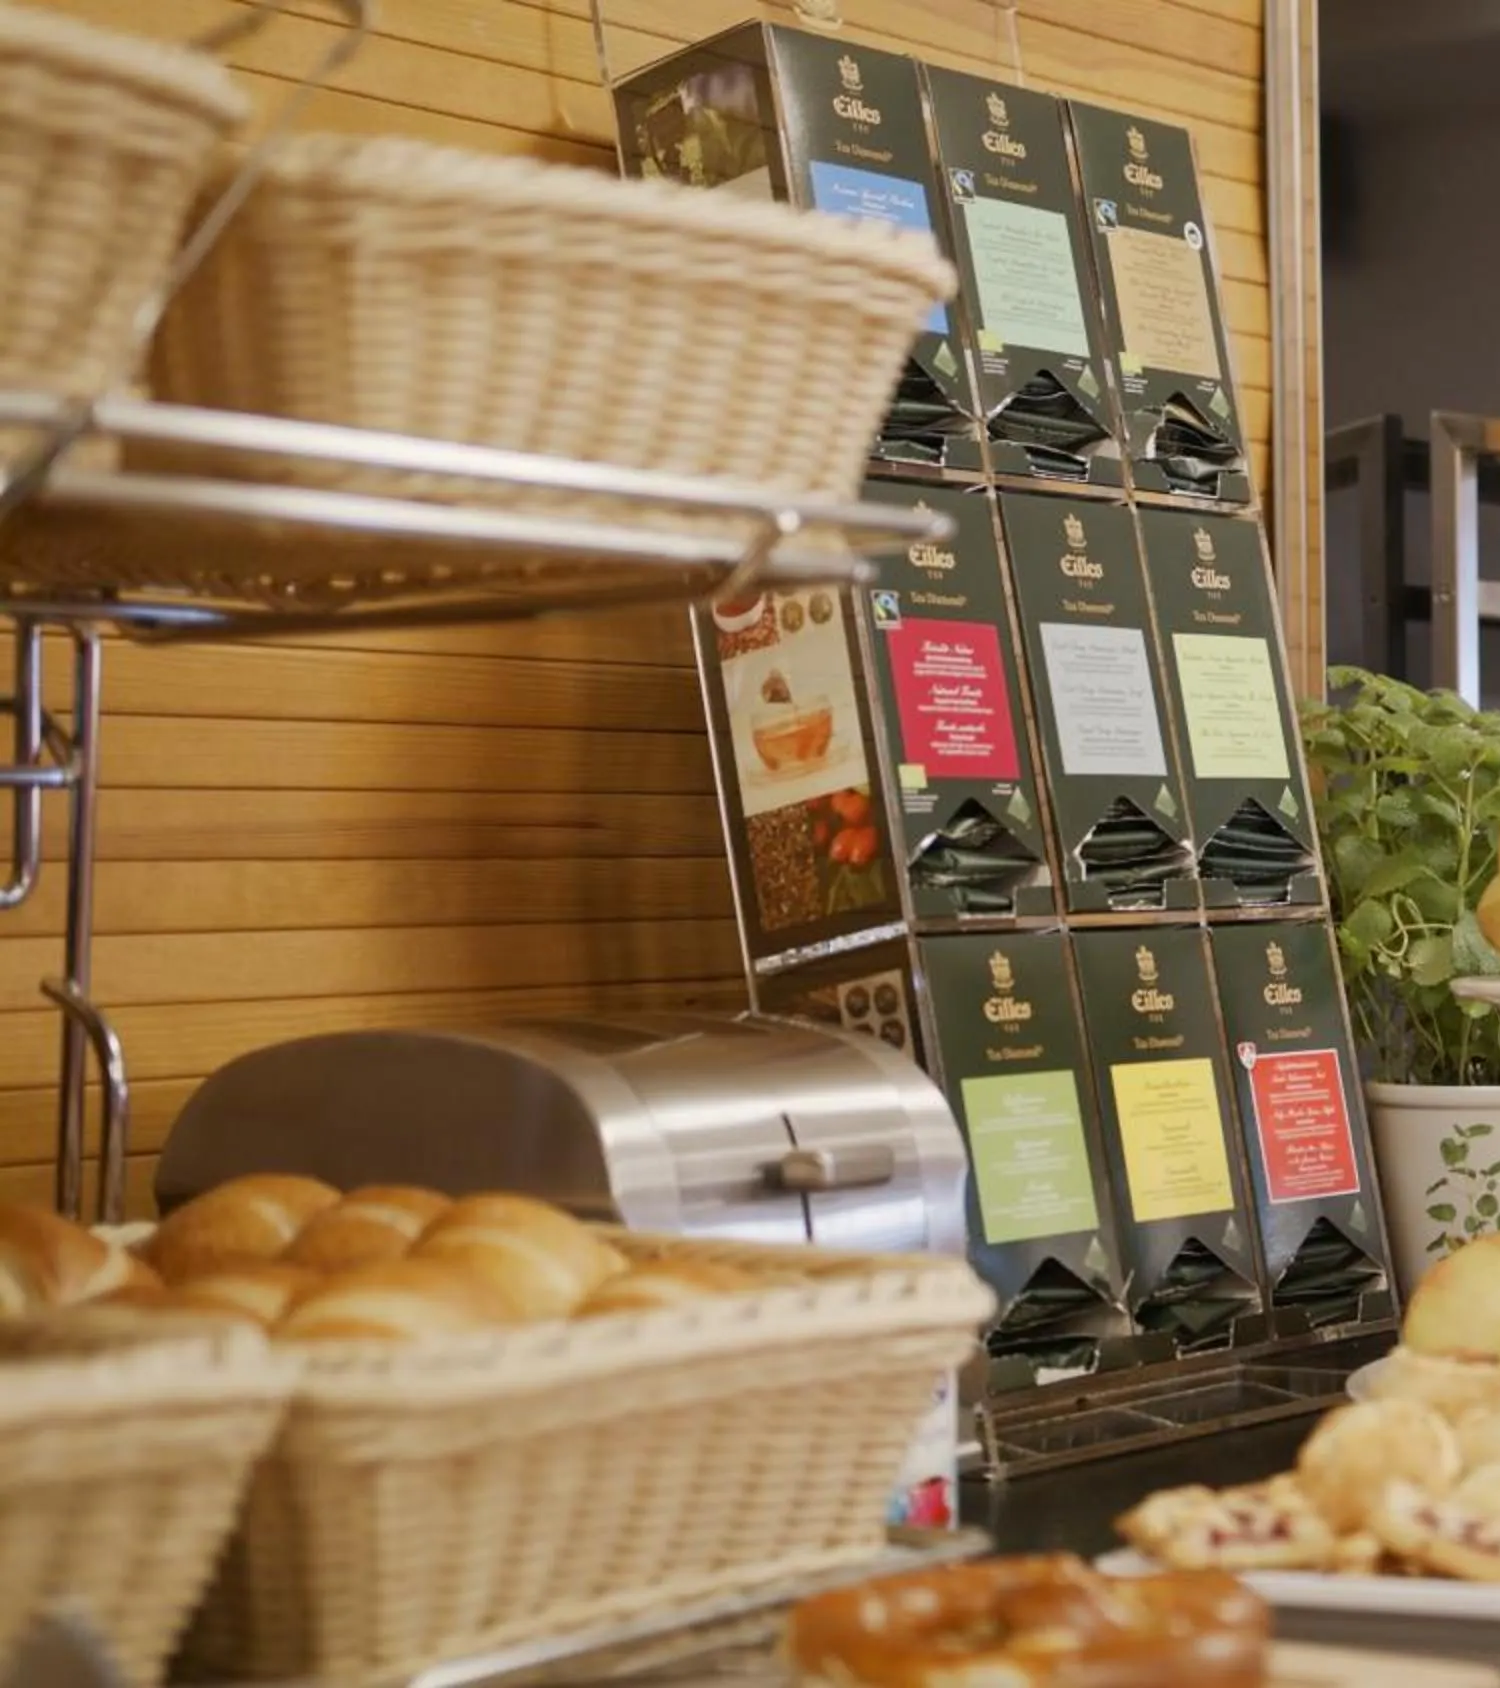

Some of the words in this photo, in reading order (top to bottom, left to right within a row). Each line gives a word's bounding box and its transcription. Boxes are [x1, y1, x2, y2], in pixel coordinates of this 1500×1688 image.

[909, 544, 955, 569] Eilles
[1060, 553, 1104, 578] Eilles
[1191, 567, 1231, 590] Eilles
[1131, 988, 1174, 1013] Eilles
[1264, 983, 1303, 1005] Eilles
